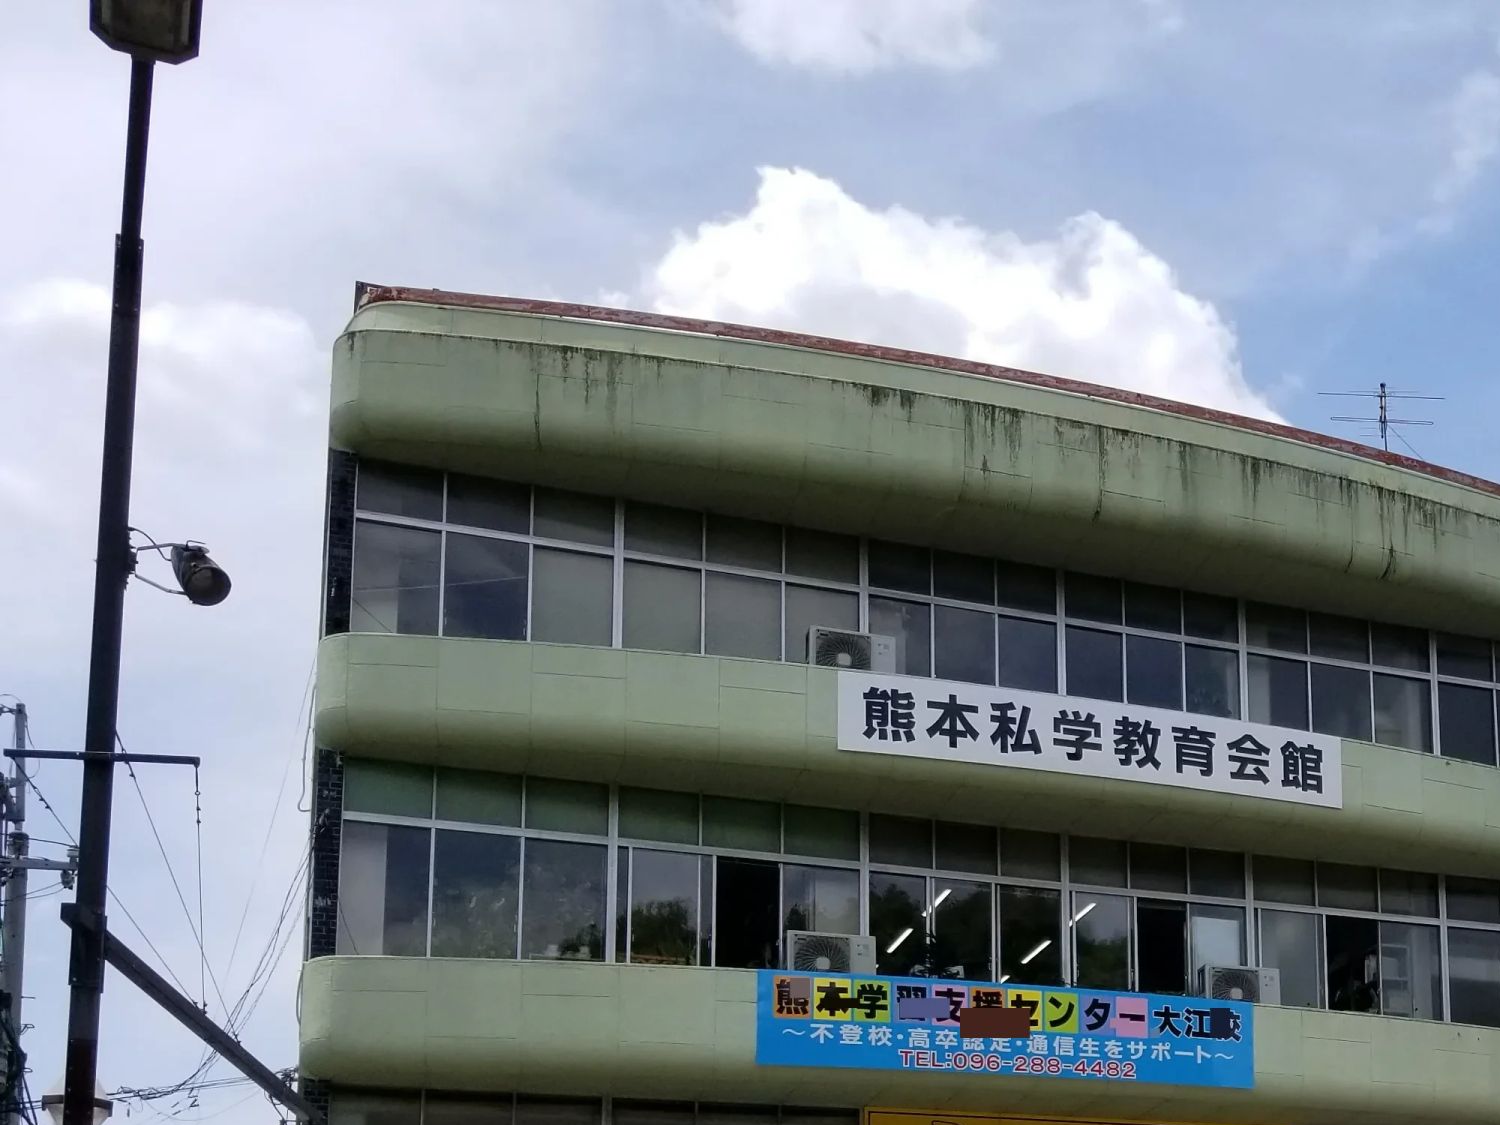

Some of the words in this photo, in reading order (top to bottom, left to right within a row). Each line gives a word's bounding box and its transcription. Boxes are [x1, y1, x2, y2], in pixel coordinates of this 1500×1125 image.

[862, 687, 1324, 794] 熊本私学教育会館
[899, 1050, 1136, 1079] TEL:096-288-4482
